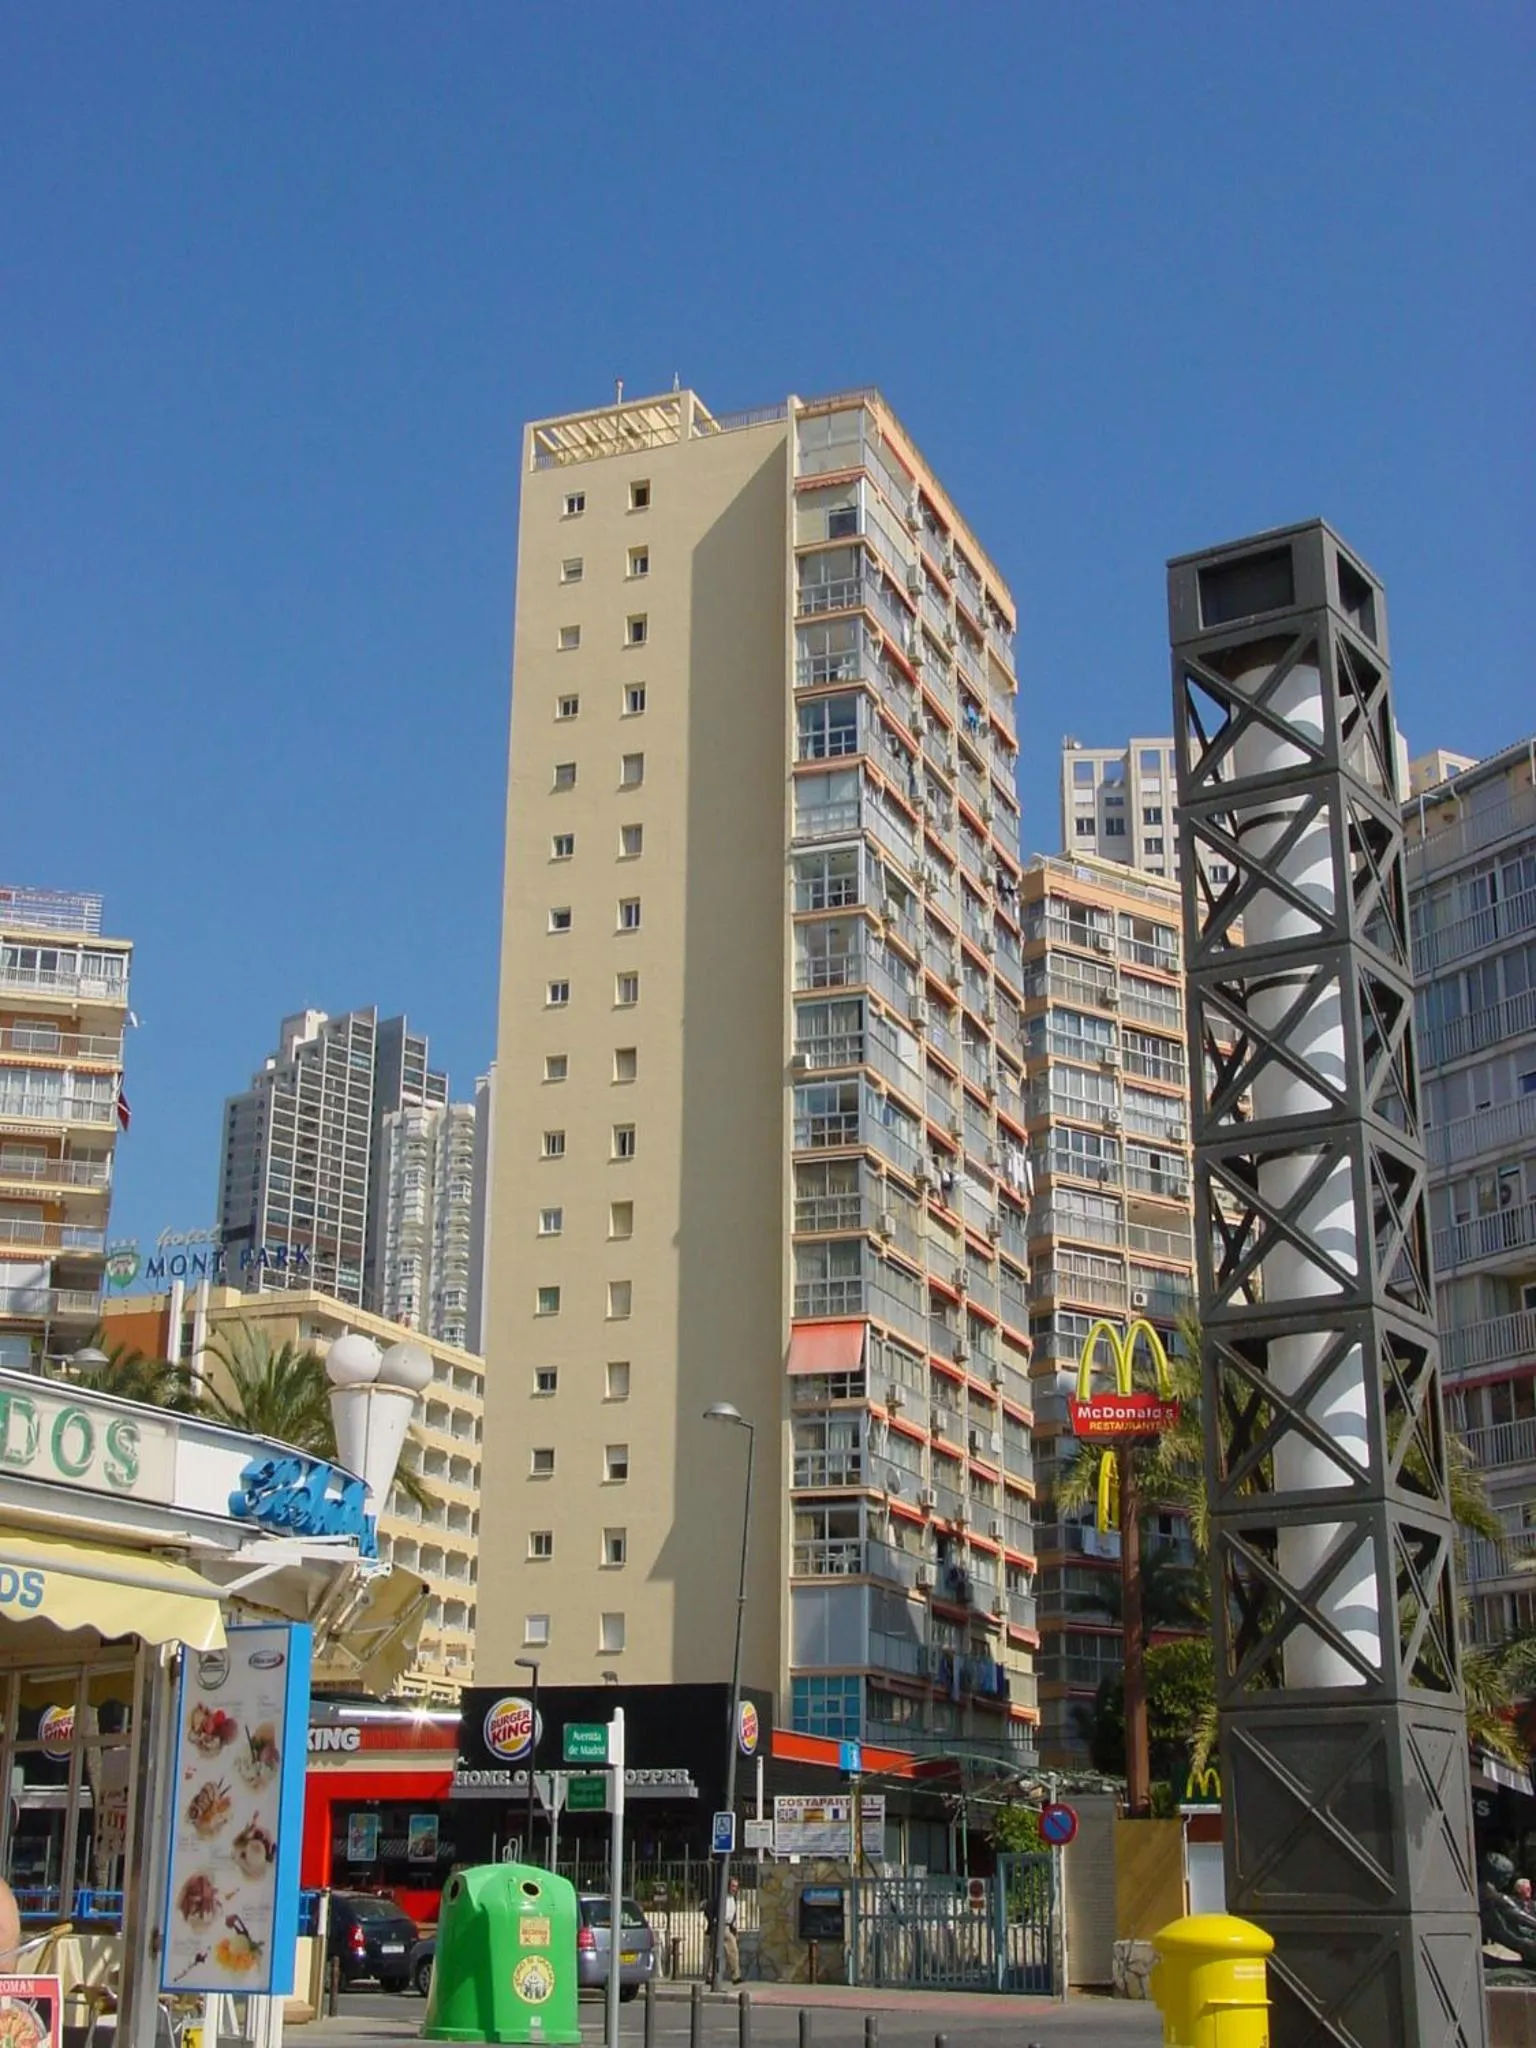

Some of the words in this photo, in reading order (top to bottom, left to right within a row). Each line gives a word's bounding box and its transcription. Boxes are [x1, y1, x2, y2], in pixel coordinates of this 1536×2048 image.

[145, 1250, 227, 1279] MONT
[240, 1243, 310, 1271] PARK
[1077, 1406, 1174, 1419] McDonald's
[44, 1716, 72, 1733] BURGE
[491, 1710, 530, 1732] BURGER
[45, 1726, 74, 1741] KIN
[492, 1720, 532, 1748] KING
[572, 1730, 602, 1742] Avenida
[568, 1744, 579, 1755] de
[580, 1743, 606, 1755] Madrid
